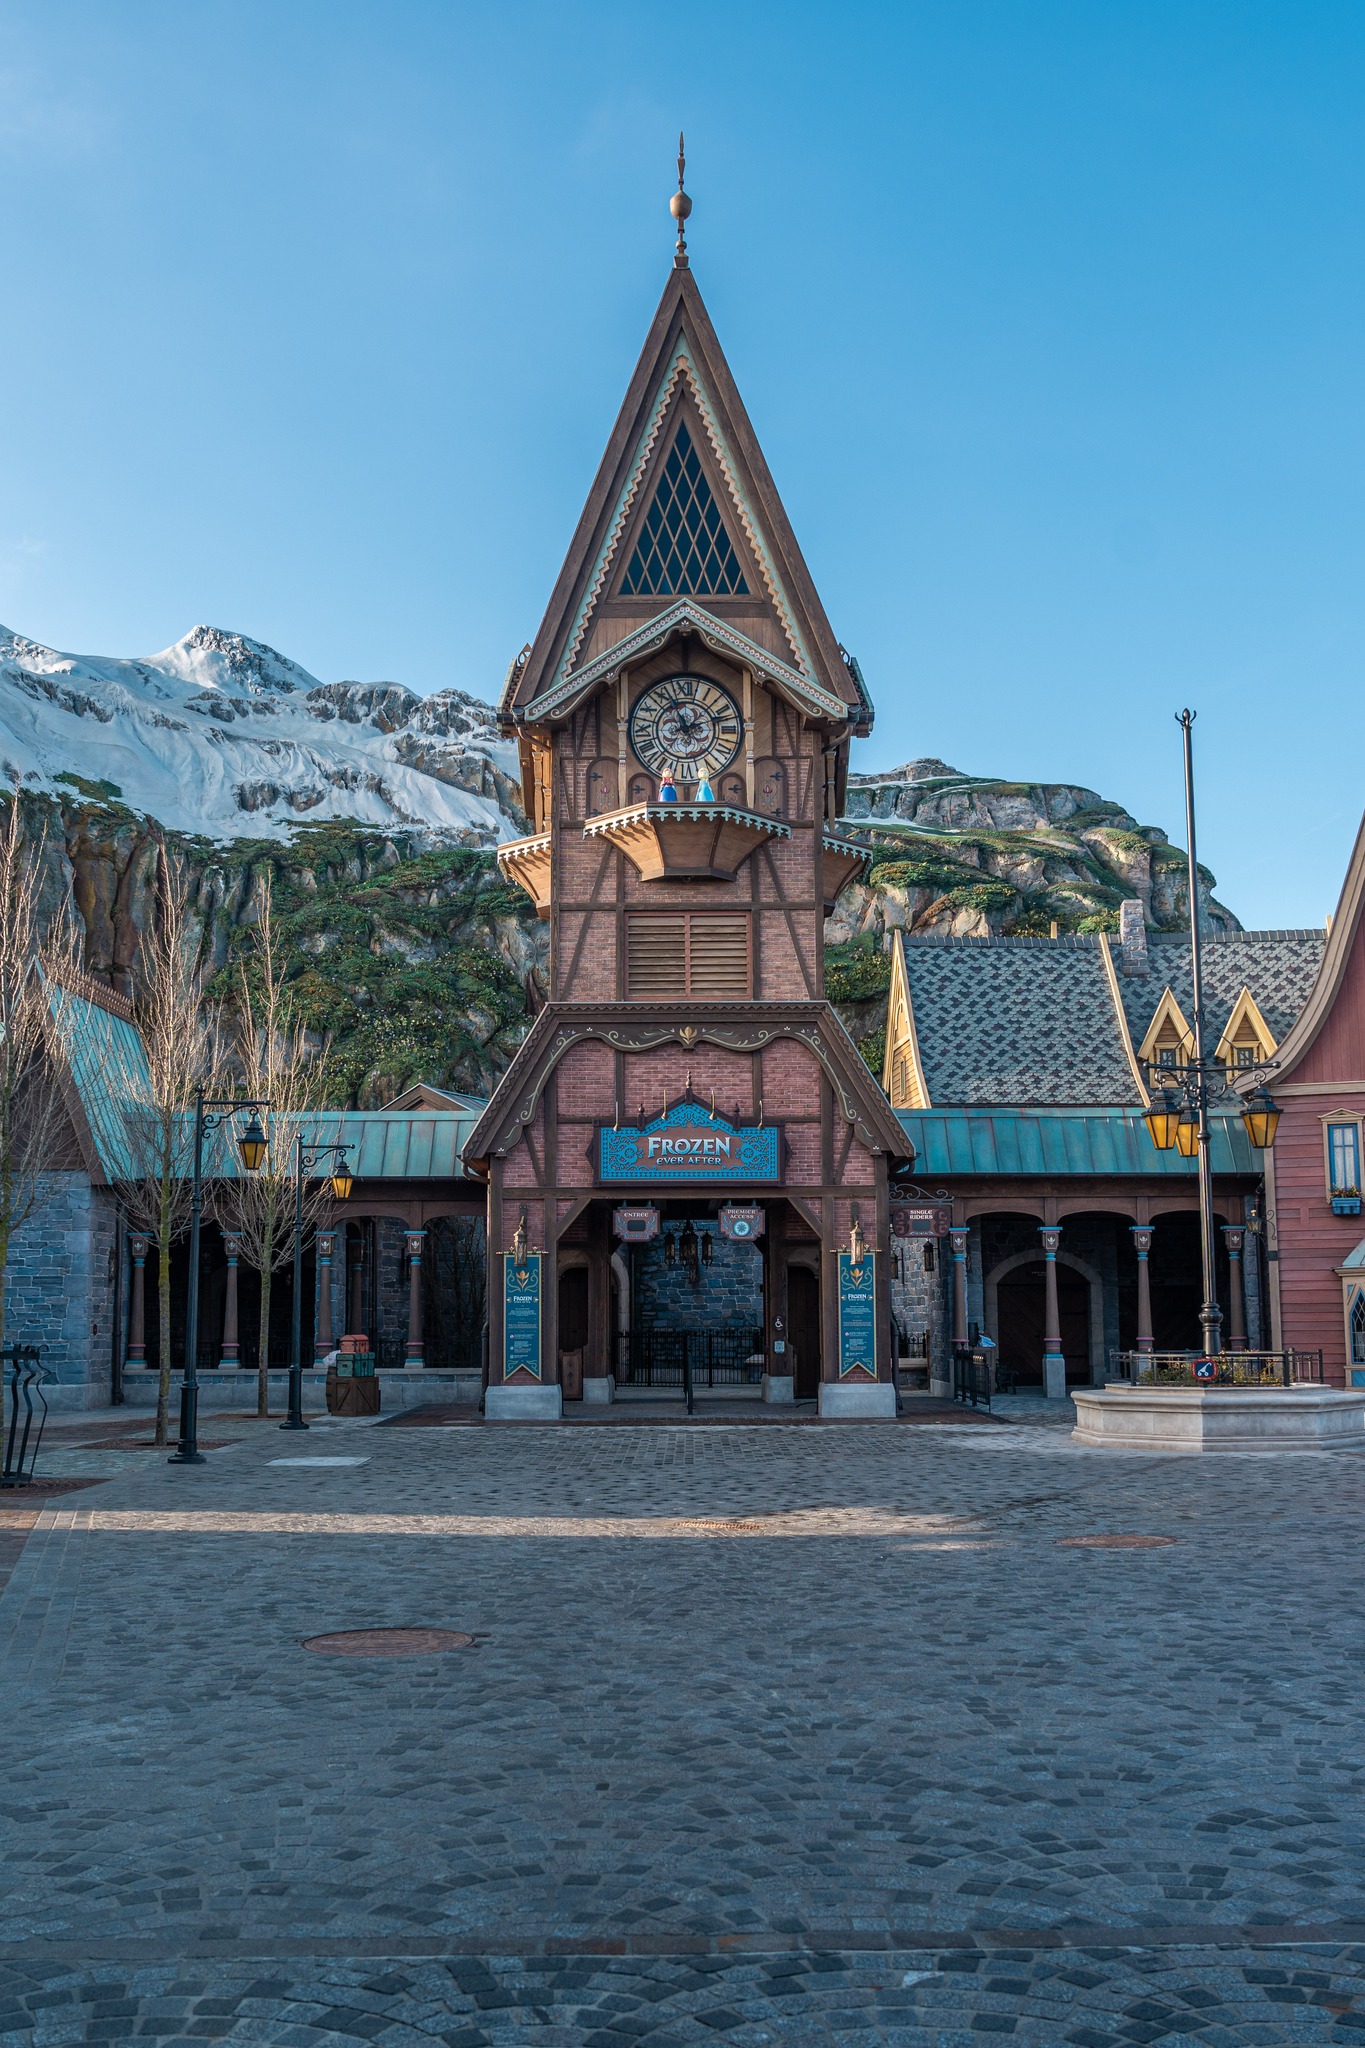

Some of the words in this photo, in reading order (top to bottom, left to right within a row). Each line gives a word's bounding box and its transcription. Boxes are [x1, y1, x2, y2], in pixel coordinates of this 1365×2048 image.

[647, 1137, 731, 1158] FROZEN
[656, 1156, 684, 1165] EVER
[687, 1156, 722, 1165] AFTER
